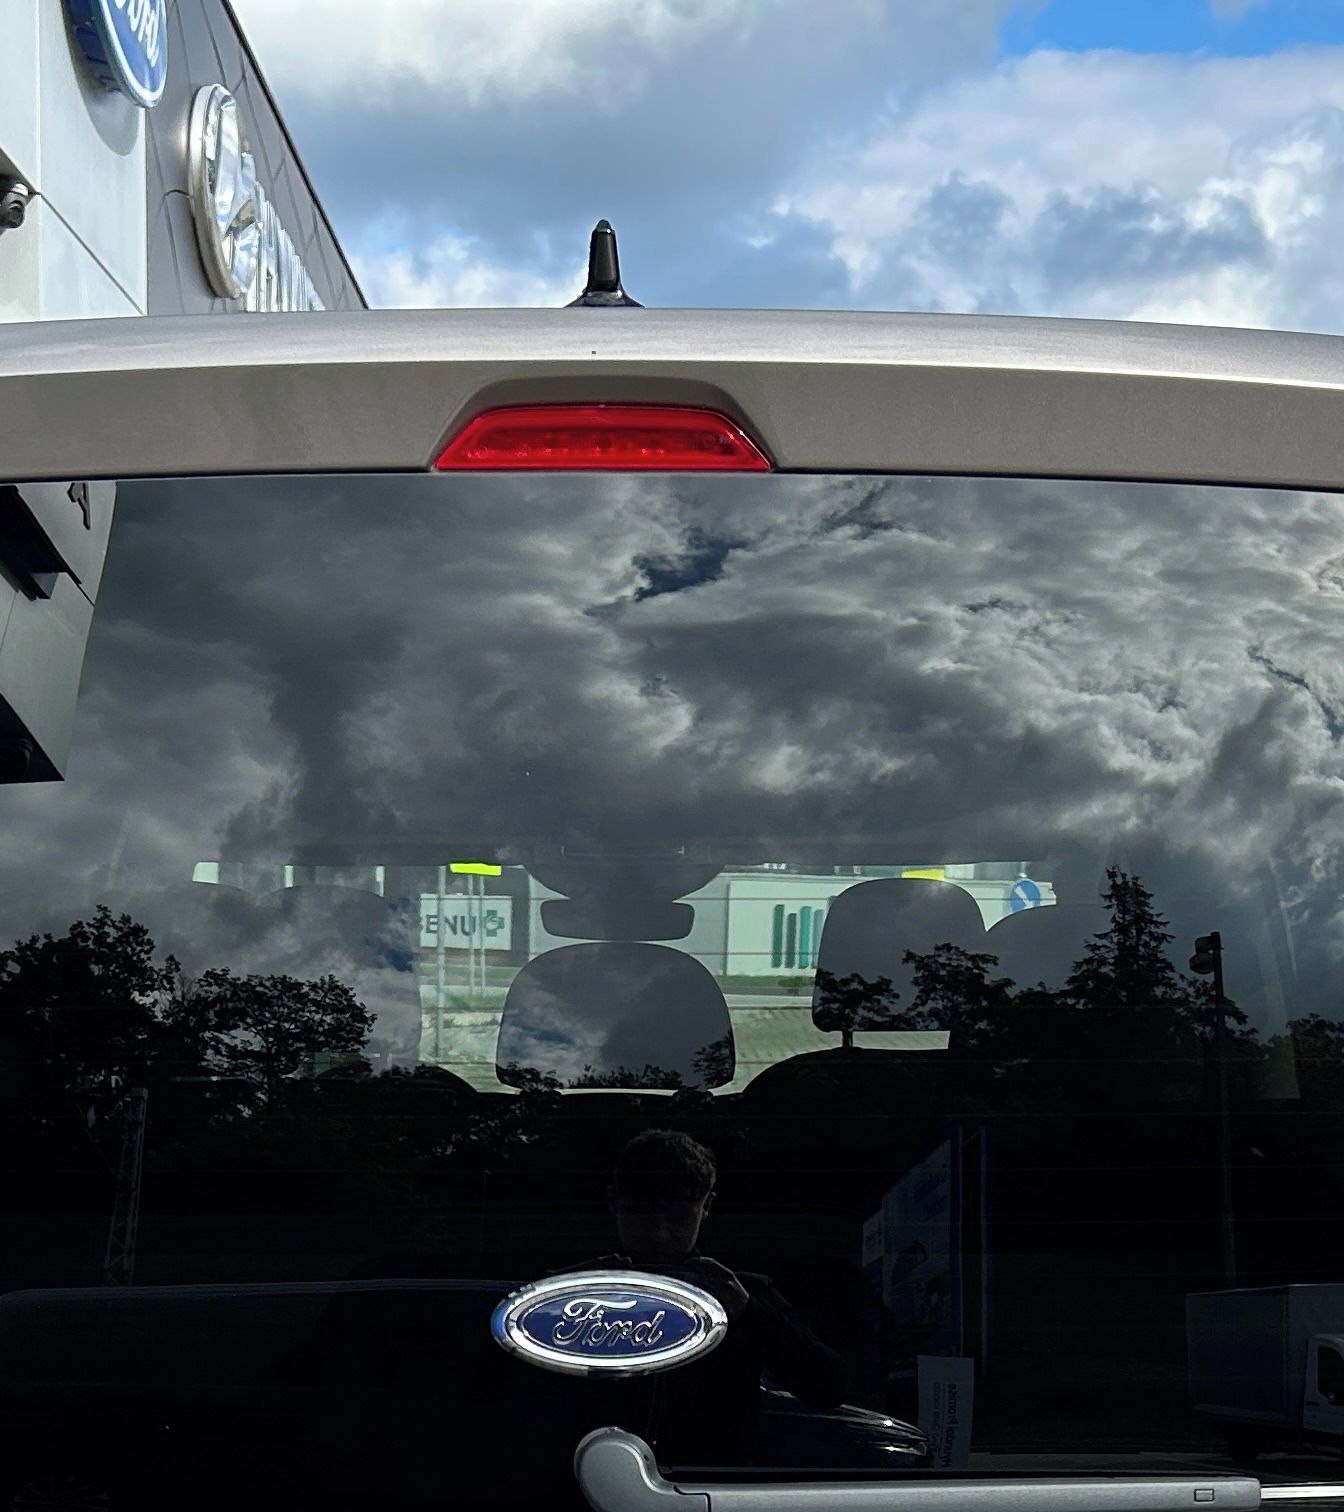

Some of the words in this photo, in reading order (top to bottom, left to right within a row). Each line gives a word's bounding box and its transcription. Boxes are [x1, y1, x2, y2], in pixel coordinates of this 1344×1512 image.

[114, 0, 159, 67] ord
[424, 914, 476, 936] ENU
[553, 1299, 666, 1347] Ford
